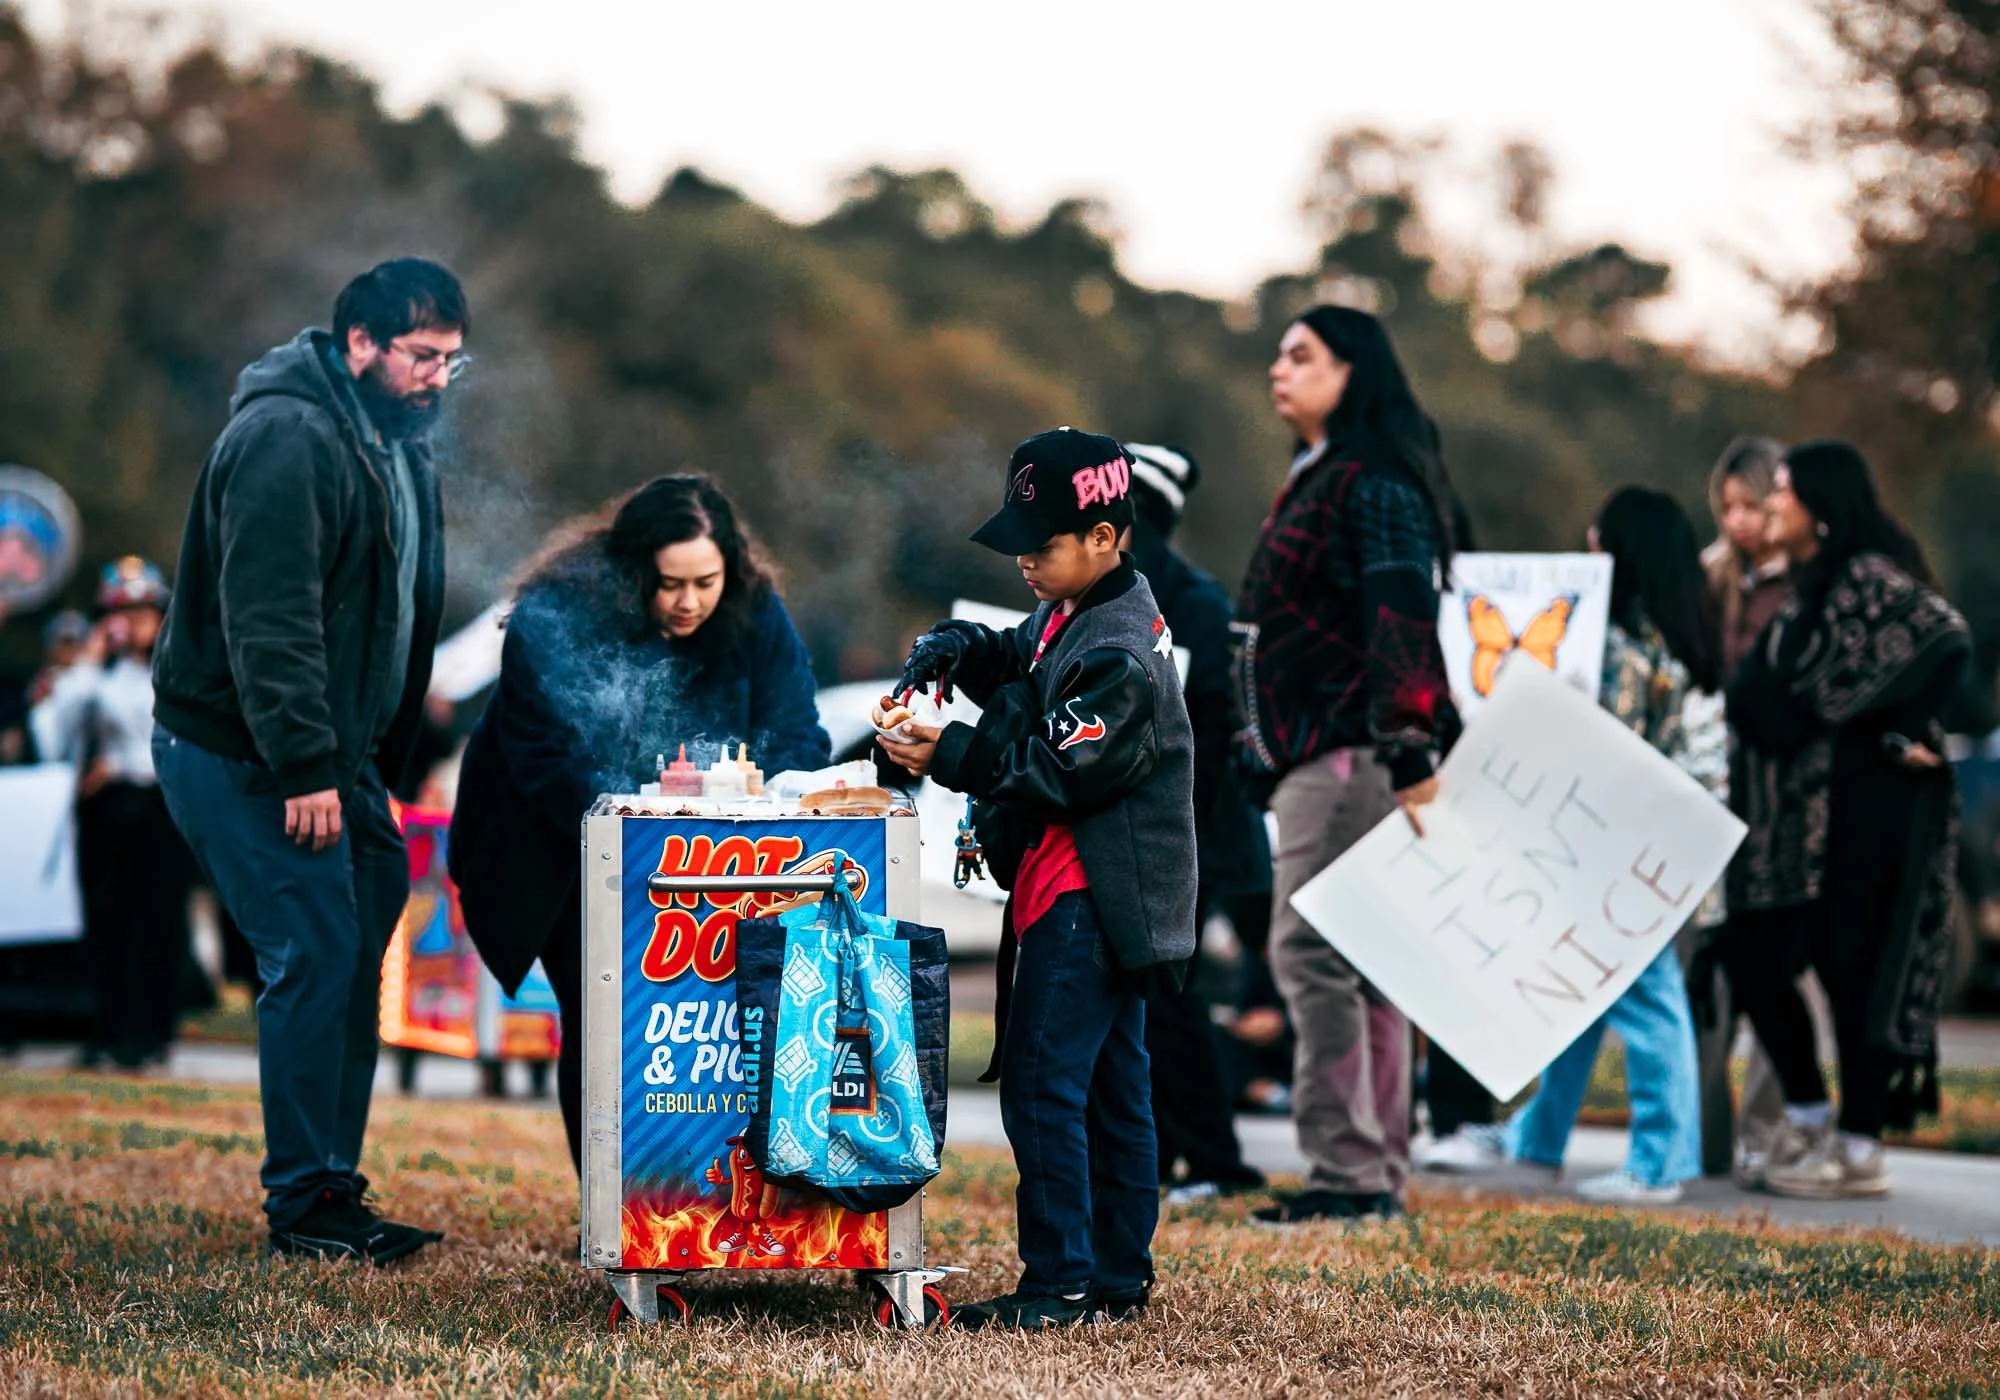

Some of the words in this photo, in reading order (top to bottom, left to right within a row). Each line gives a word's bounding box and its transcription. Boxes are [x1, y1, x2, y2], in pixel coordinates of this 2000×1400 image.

[648, 835, 803, 909] HOT
[641, 908, 786, 982] DO
[1513, 843, 1694, 1028] NICE
[644, 999, 740, 1044] DELIC
[643, 1045, 677, 1085] &
[690, 1043, 745, 1084] PIC
[743, 1006, 764, 1114] aldi.us
[832, 1081, 865, 1097] LDI
[645, 1092, 717, 1113] CEBOLLA
[722, 1093, 732, 1113] Y
[736, 1093, 749, 1114] C
